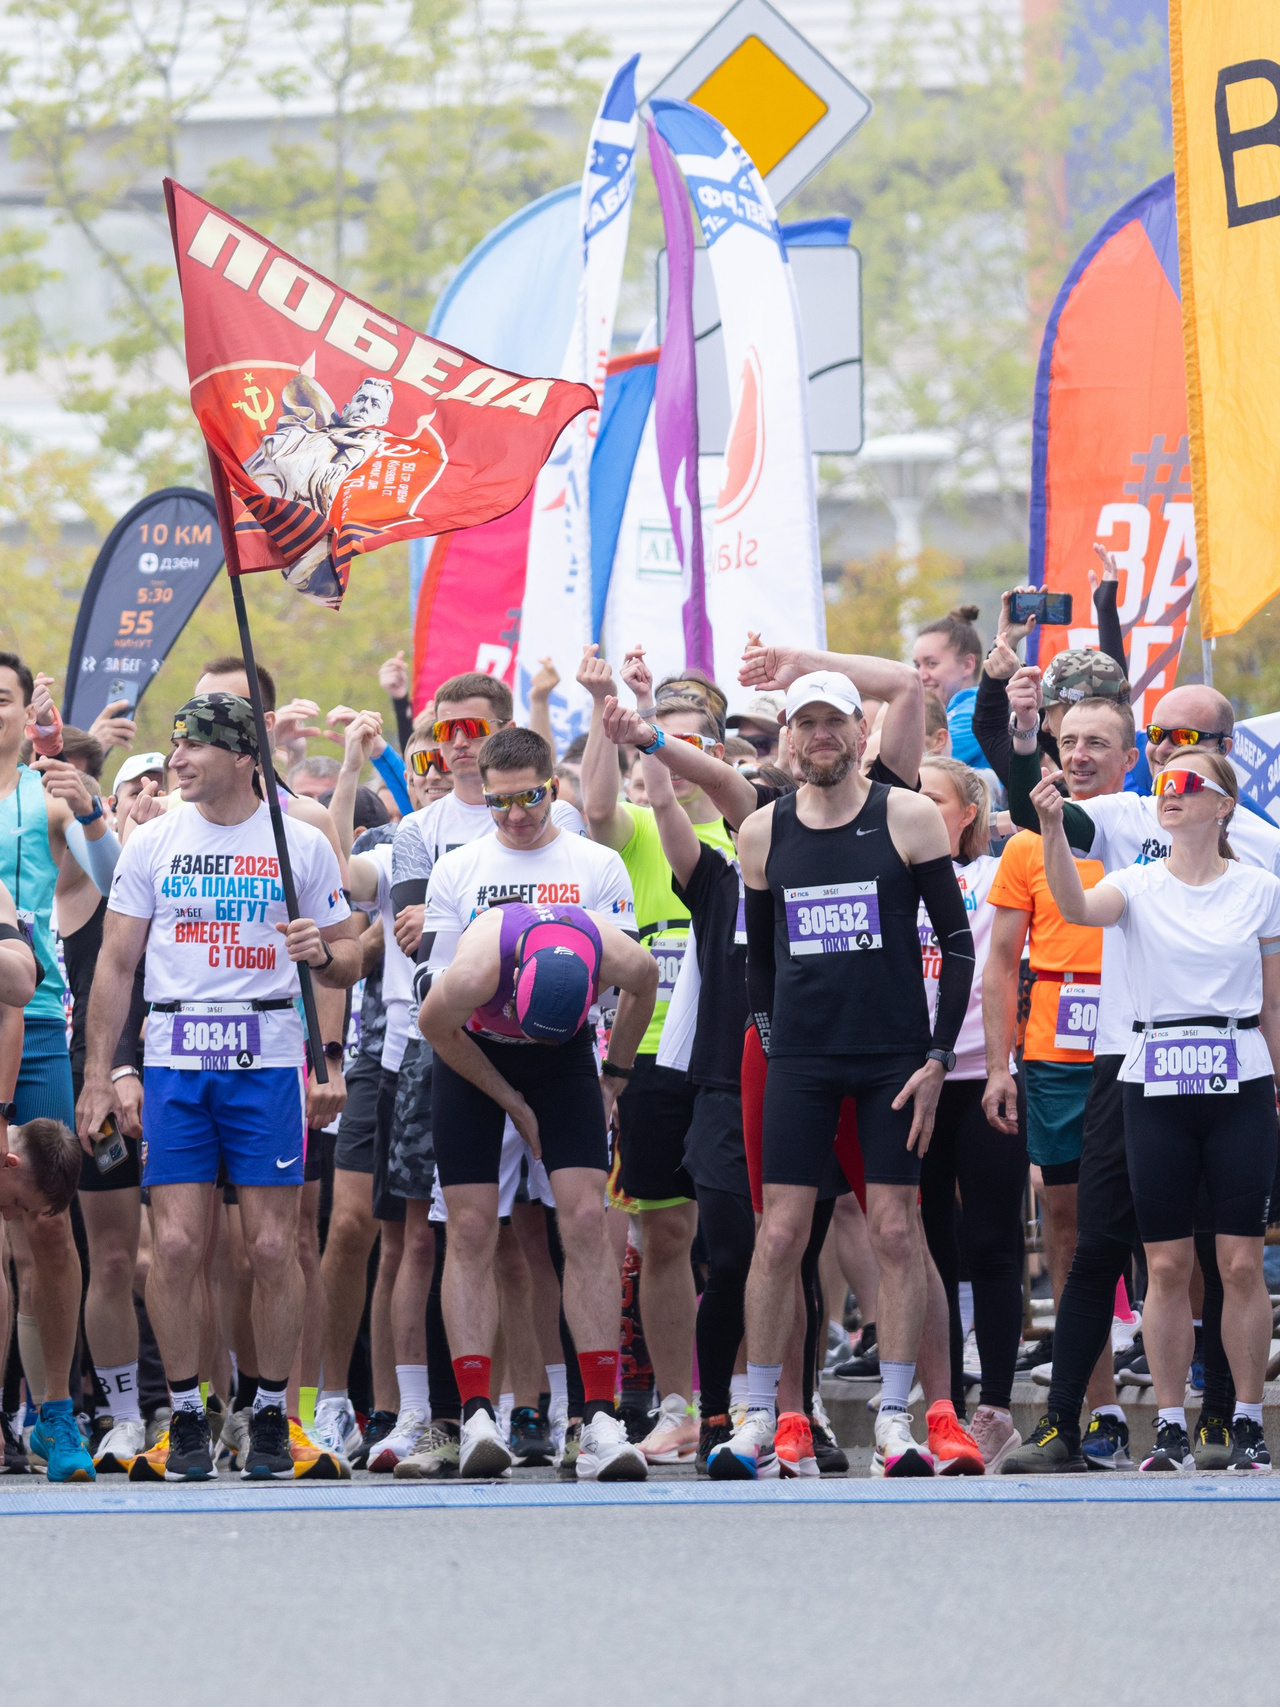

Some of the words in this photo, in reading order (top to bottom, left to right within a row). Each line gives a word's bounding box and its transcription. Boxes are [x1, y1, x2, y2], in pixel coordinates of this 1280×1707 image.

[187, 211, 554, 416] ПОБЕДА
[139, 524, 168, 545] 10
[137, 587, 173, 604] 5:30
[118, 610, 154, 635] 55
[171, 854, 279, 878] #ЗАБЕГ2025
[161, 875, 197, 898] 45%
[202, 877, 286, 902] ПЛАНЕТЫ
[215, 899, 269, 923] БЕГУТ
[797, 902, 869, 936] 30532
[175, 921, 240, 944] ВМЕСТЕ
[208, 944, 219, 968] С
[224, 944, 277, 970] ТОБОЙ
[1068, 1002, 1097, 1032] 30
[182, 1022, 248, 1051] 30341
[239, 1053, 251, 1064] A
[1154, 1045, 1228, 1076] 30092
[1212, 1077, 1224, 1088] A
